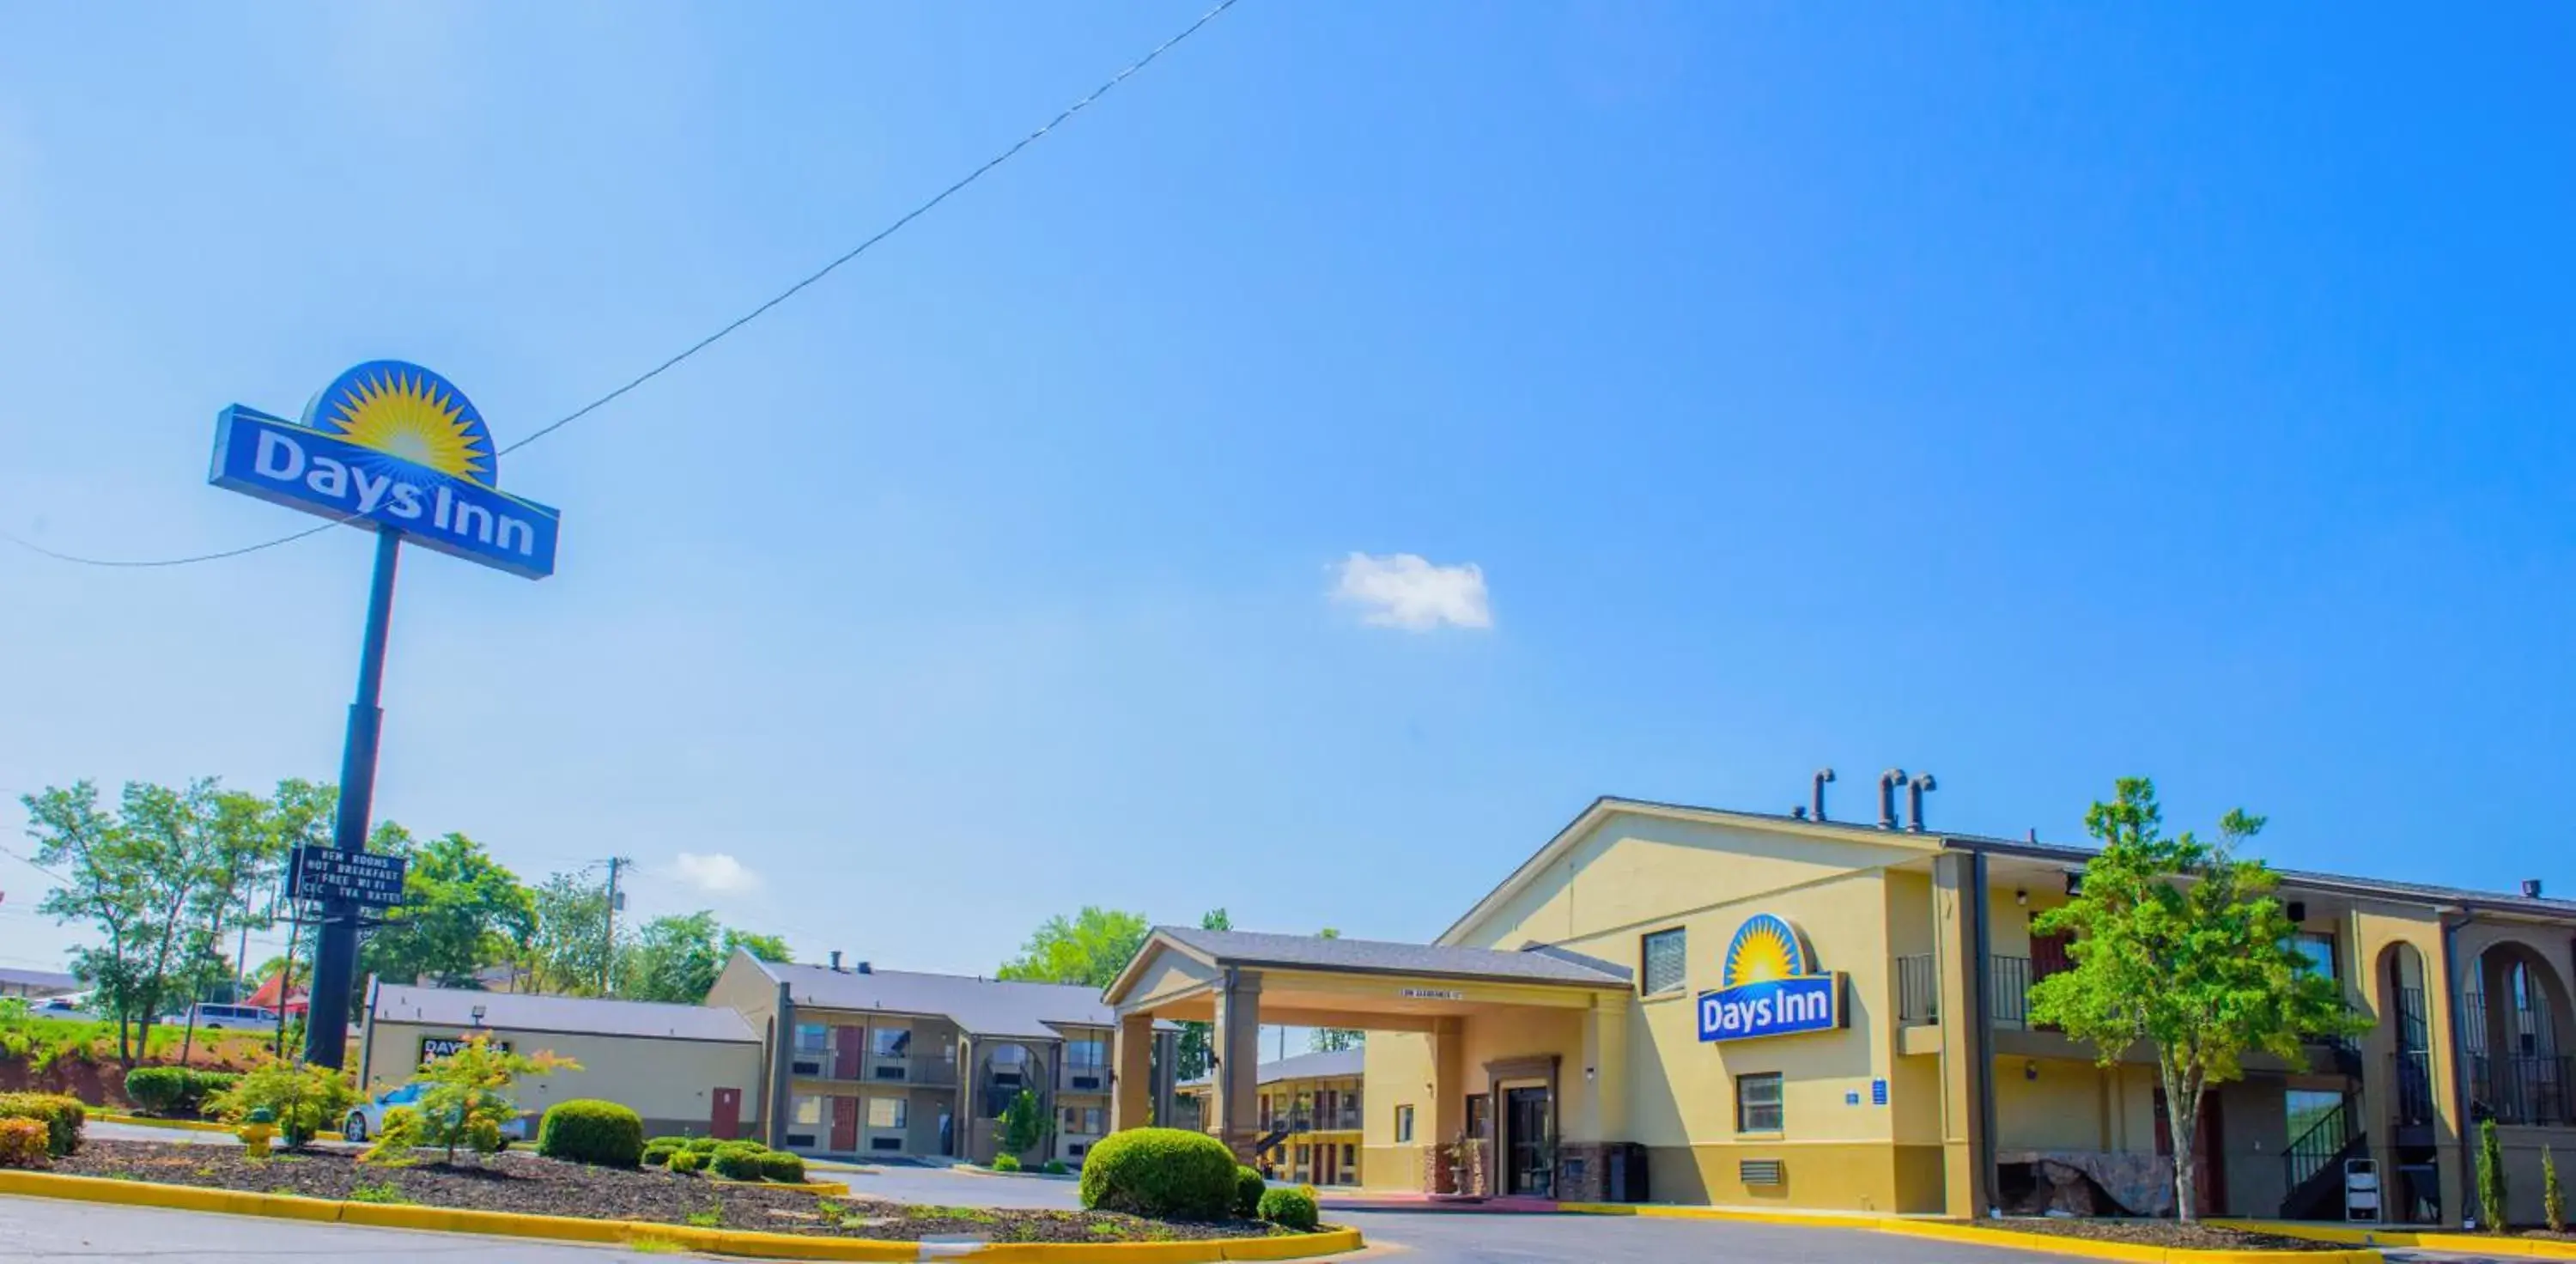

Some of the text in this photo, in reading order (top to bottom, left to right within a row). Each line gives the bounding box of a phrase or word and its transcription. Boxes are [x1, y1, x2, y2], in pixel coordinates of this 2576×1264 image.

[254, 429, 534, 556] Days Inn
[352, 854, 389, 868] ROOMS
[322, 874, 349, 885] FREE
[337, 865, 399, 880] BREAKFAST
[1703, 988, 1827, 1034] Days Inn
